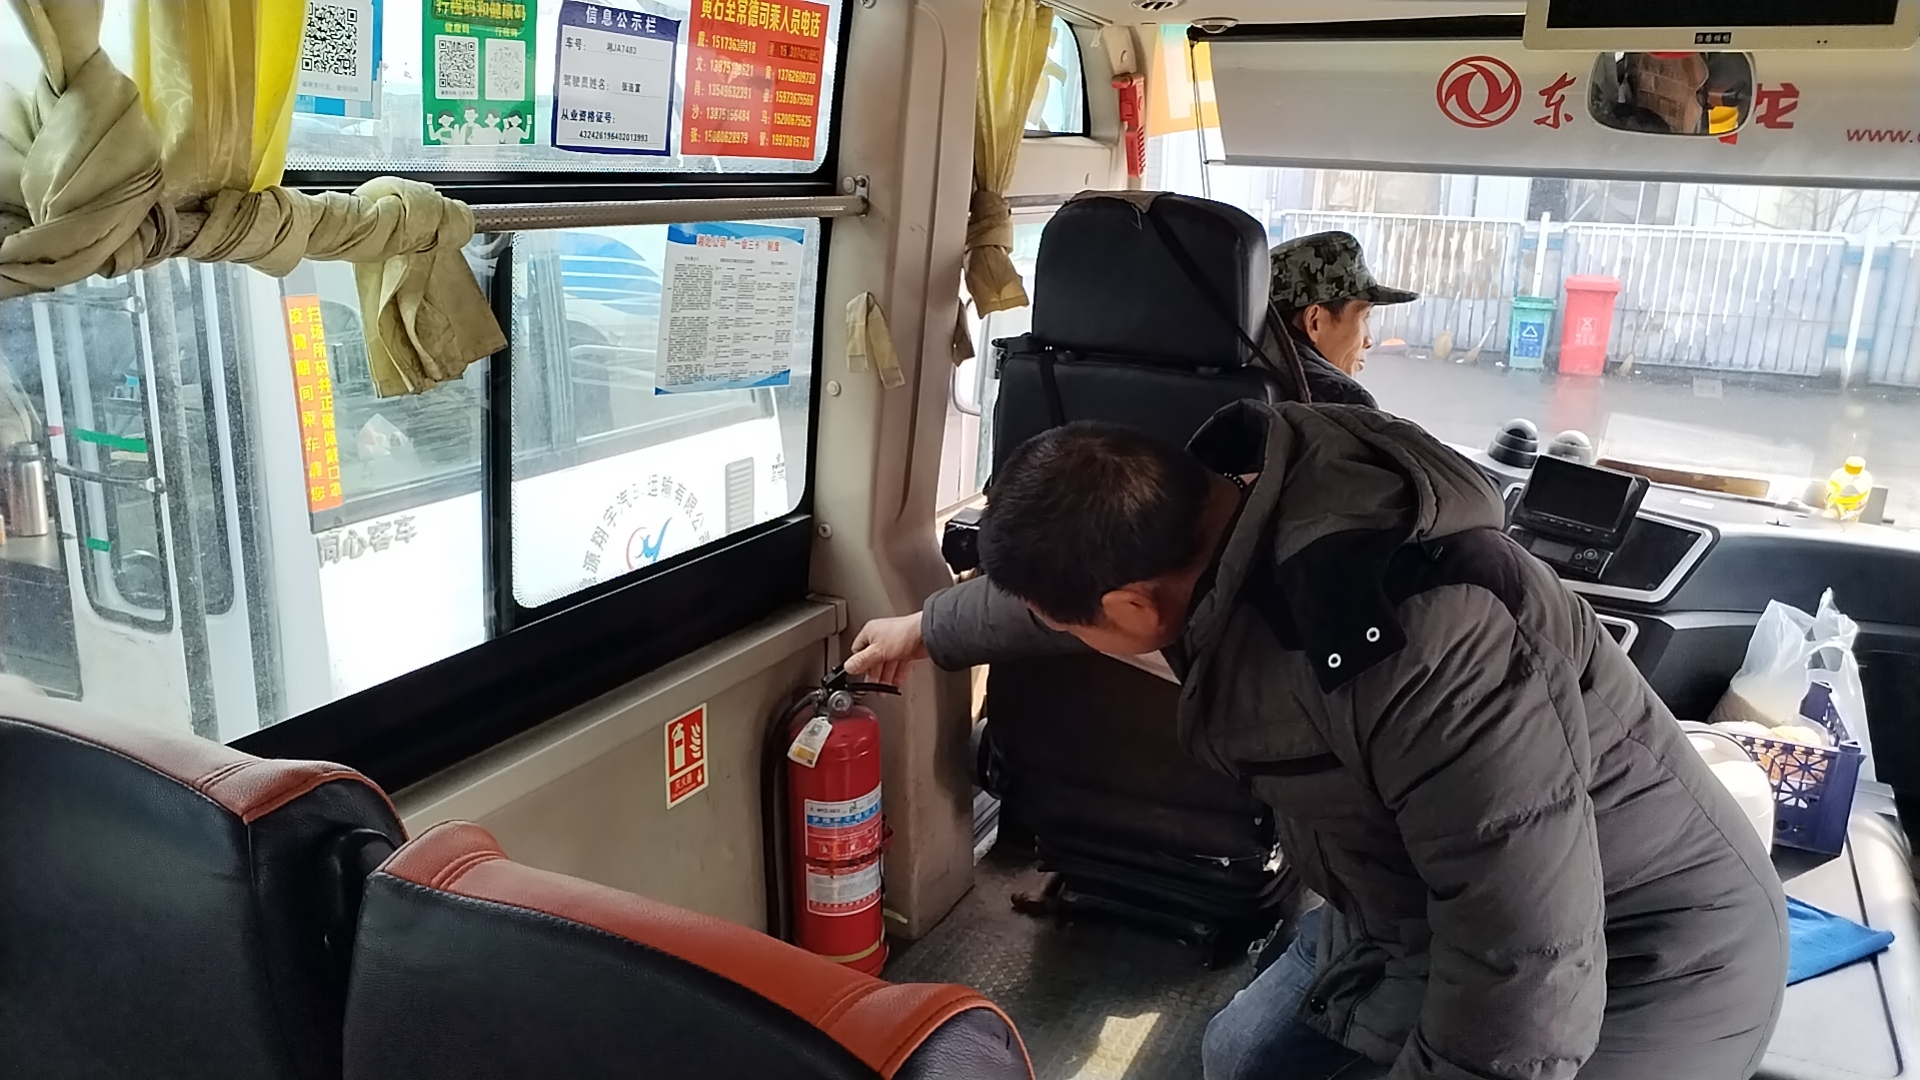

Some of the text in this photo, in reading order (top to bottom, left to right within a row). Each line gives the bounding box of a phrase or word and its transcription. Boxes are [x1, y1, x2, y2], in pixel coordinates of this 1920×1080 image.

[586, 5, 657, 33] 信息公示栏
[565, 36, 586, 51] 车号：
[563, 74, 610, 91] 驾驶员姓名：
[1533, 72, 1578, 130] 东
[561, 107, 616, 124] 从业资格证号：
[306, 305, 343, 499] 扫场所码并正确佩戴口罩
